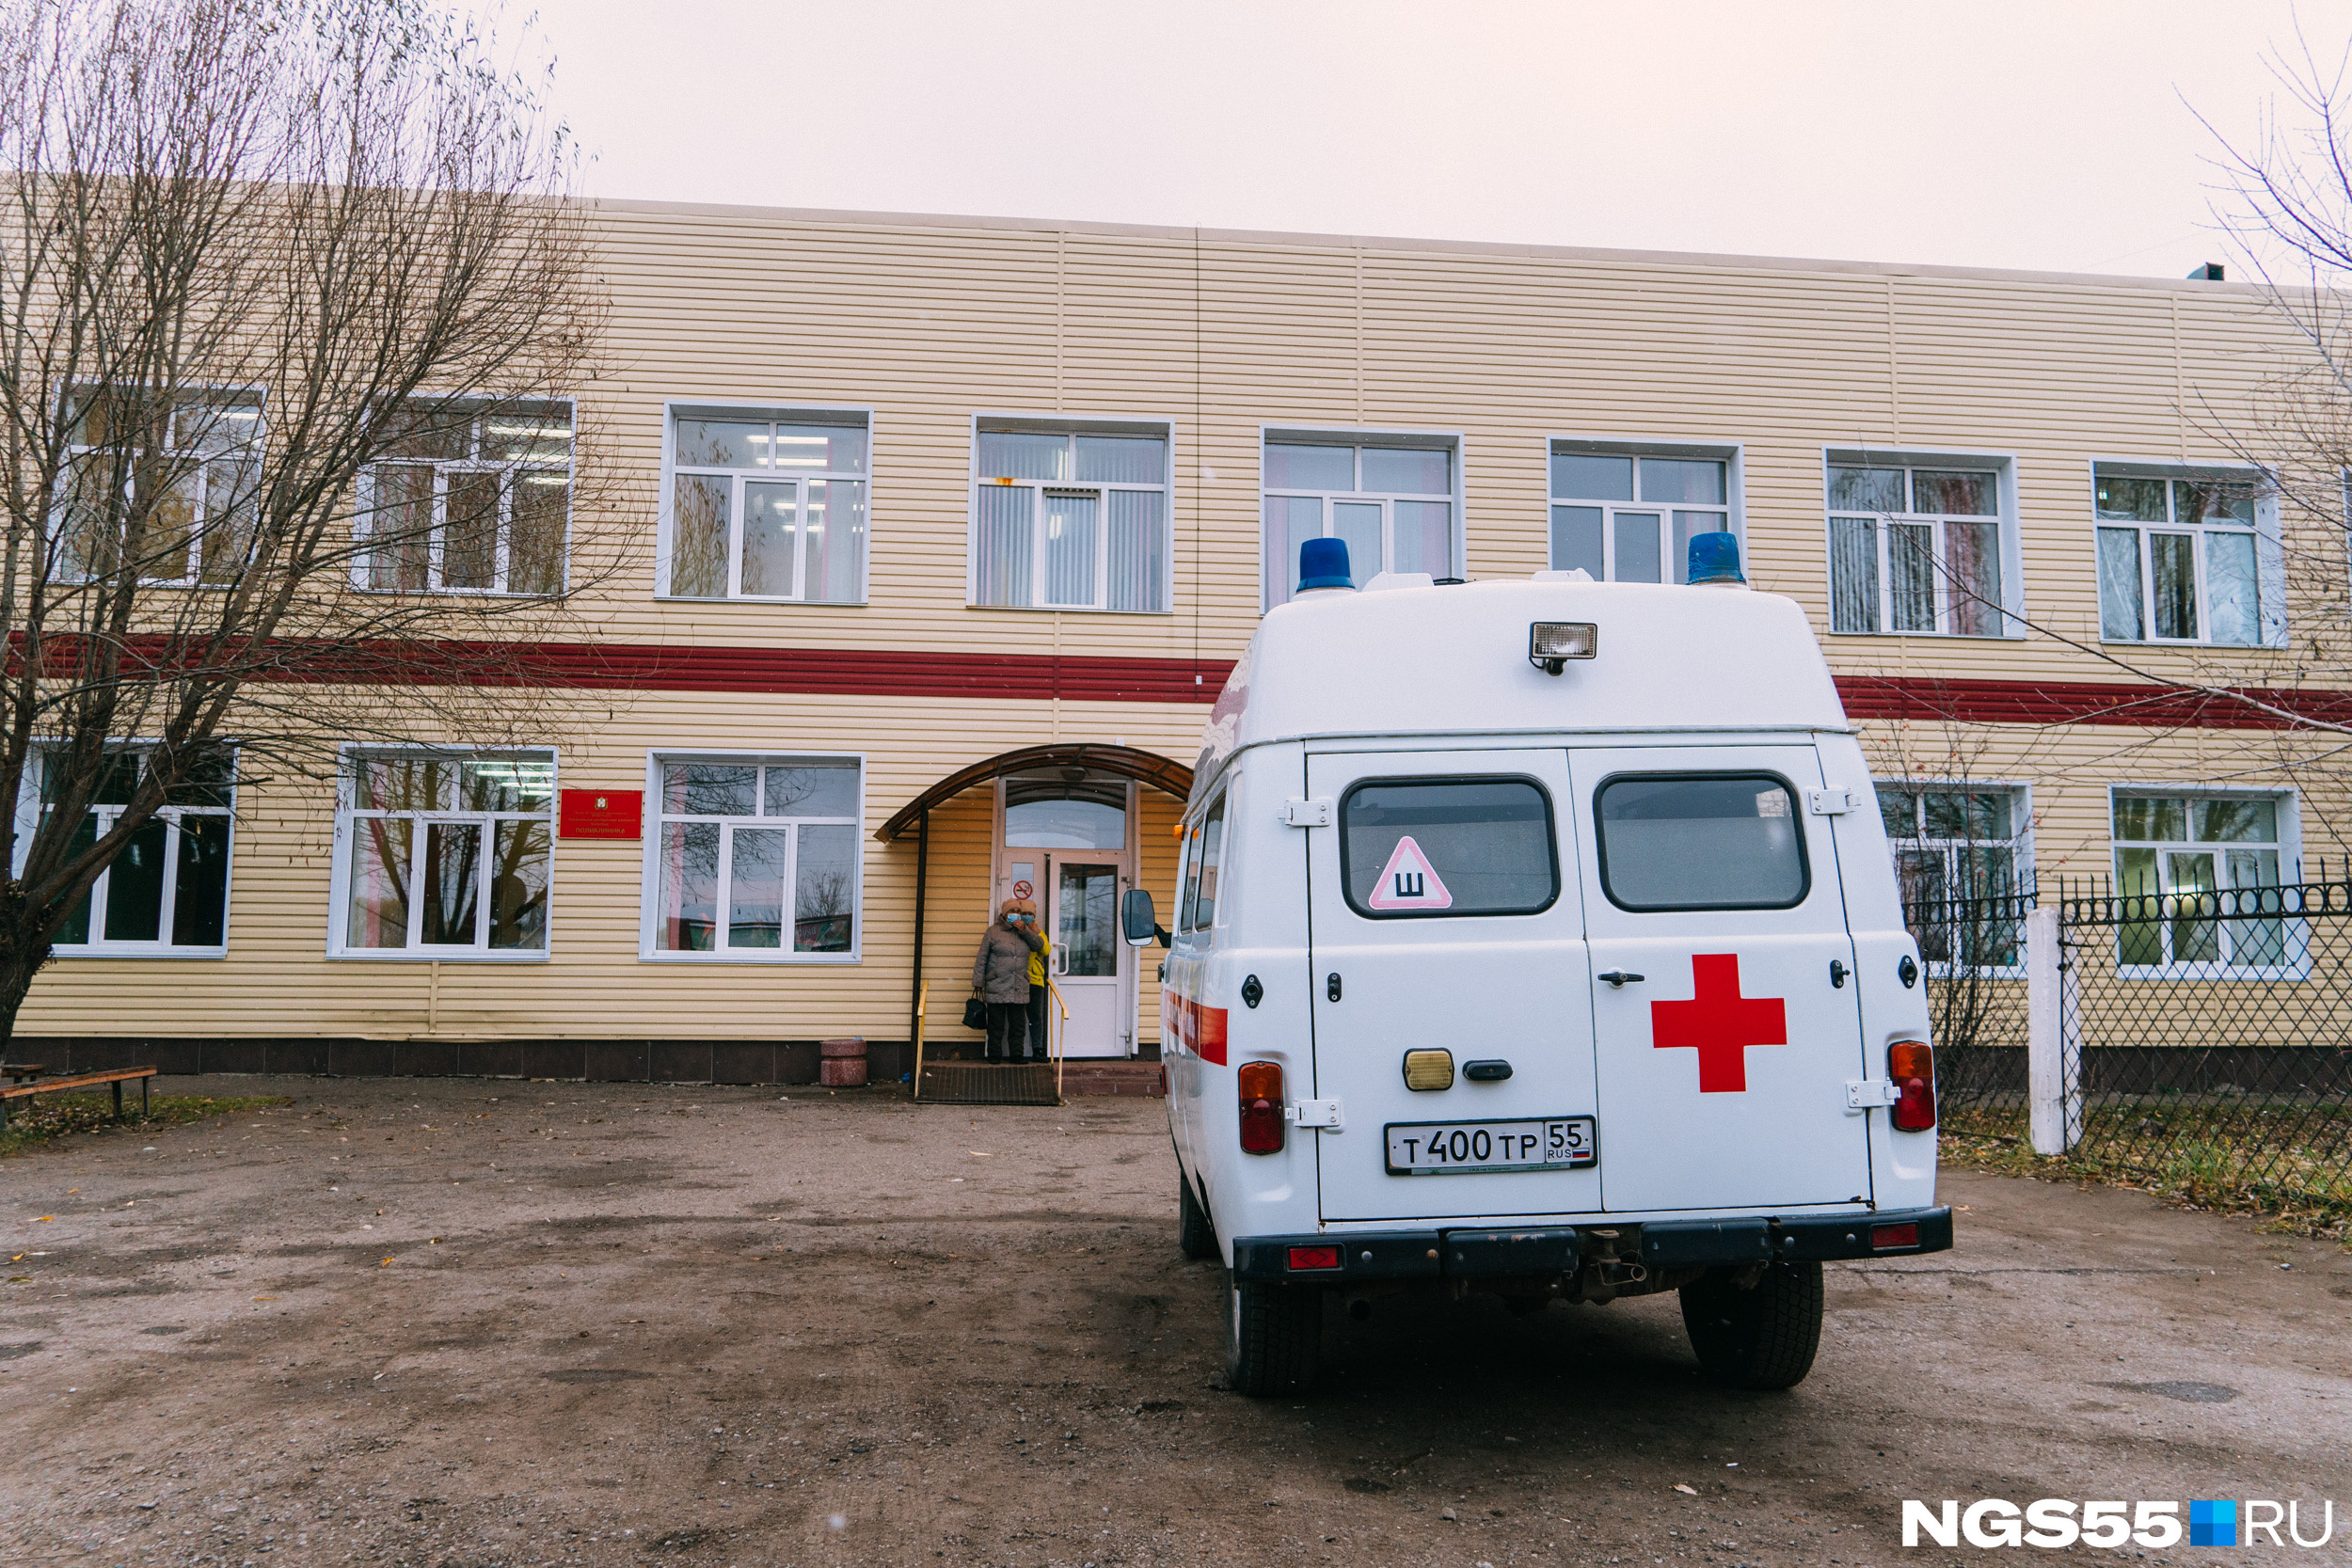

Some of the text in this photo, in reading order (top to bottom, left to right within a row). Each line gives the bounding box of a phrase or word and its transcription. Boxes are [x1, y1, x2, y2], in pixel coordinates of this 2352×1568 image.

[1395, 872, 1424, 897] Ш
[1549, 1123, 1582, 1148] 55
[1547, 1148, 1572, 1159] RUS
